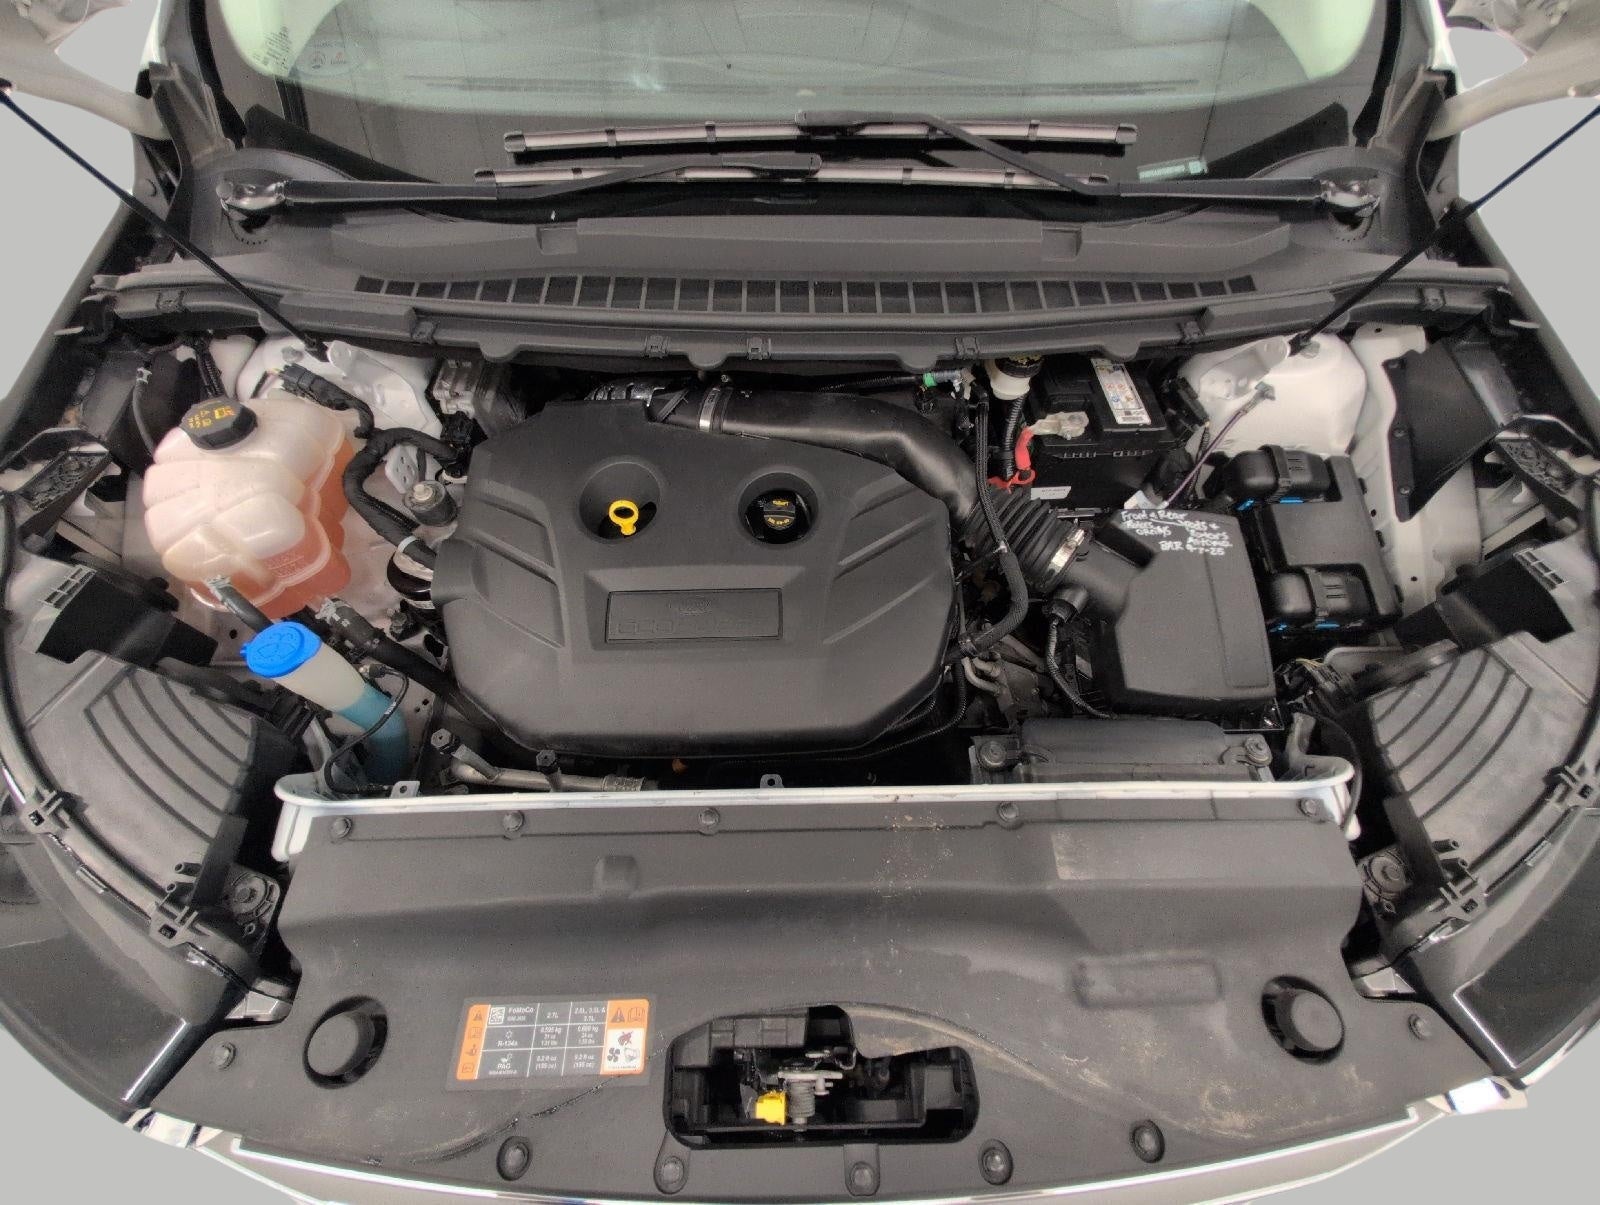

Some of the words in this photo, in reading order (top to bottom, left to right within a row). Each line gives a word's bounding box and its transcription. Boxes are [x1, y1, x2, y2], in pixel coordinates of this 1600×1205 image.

[1121, 510, 1148, 521] Front
[1158, 510, 1188, 520] Rear
[508, 1006, 534, 1014] FoMoCo
